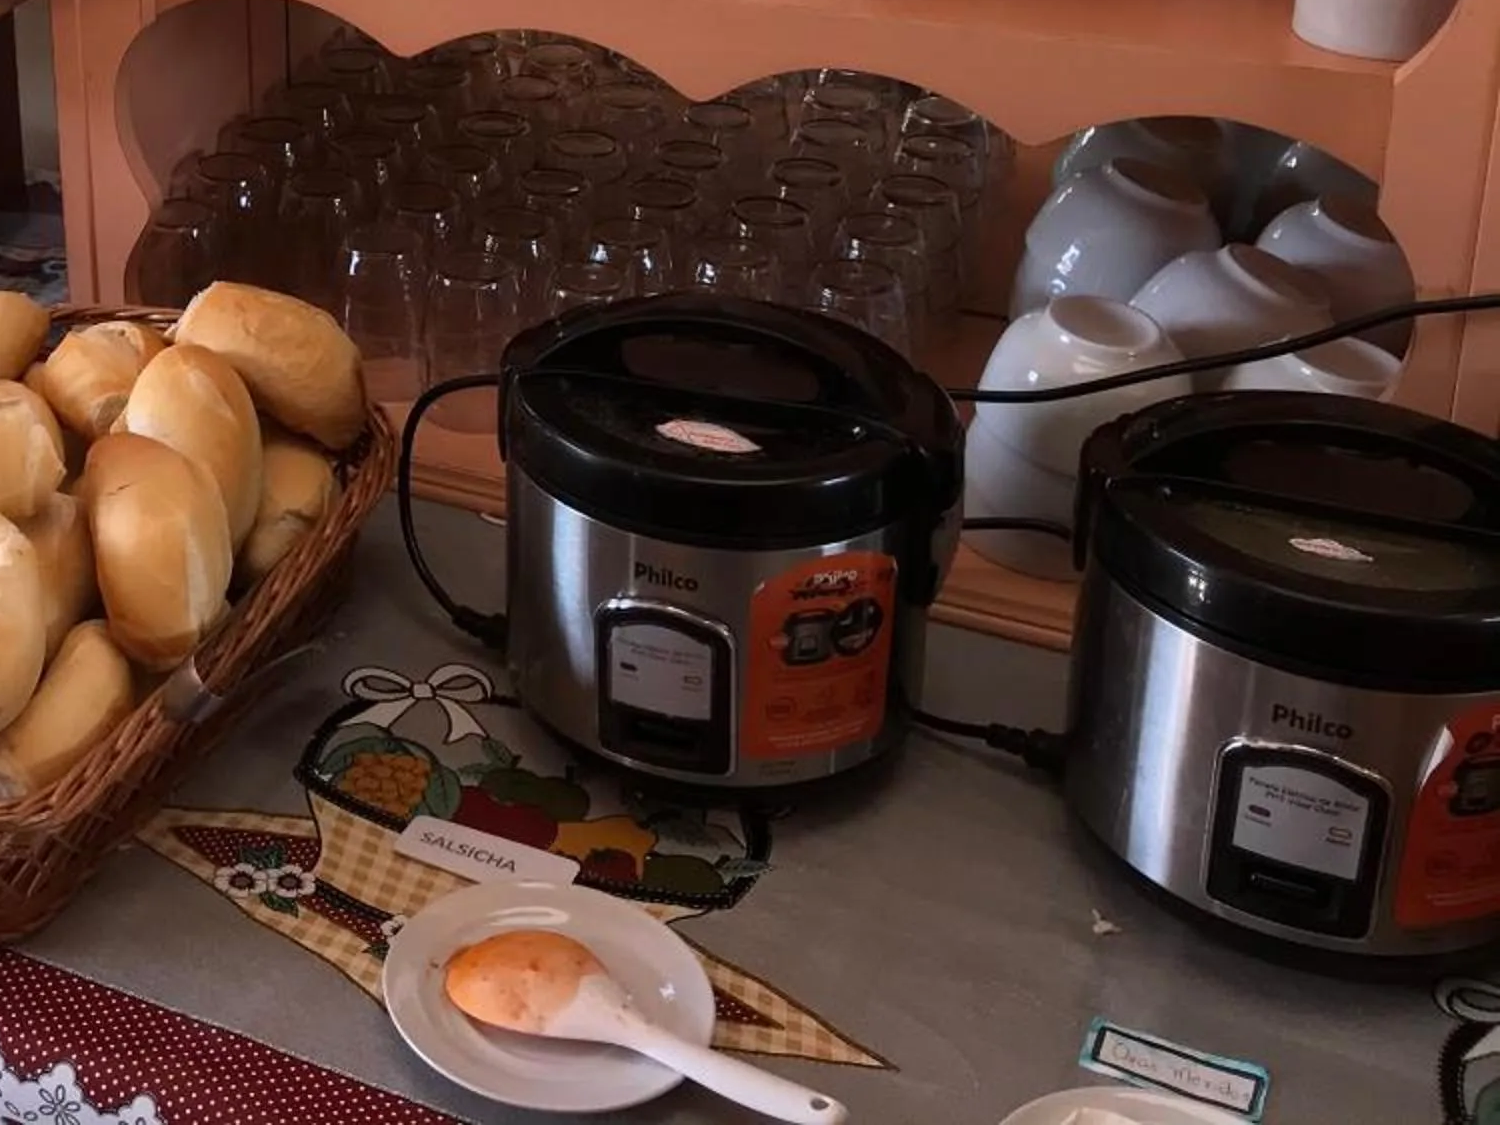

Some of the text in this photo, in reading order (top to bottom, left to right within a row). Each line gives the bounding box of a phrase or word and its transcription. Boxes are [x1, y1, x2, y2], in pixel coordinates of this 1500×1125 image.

[634, 560, 699, 593] Philco
[1271, 703, 1355, 741] Philco
[419, 831, 517, 873] SALSICHA
